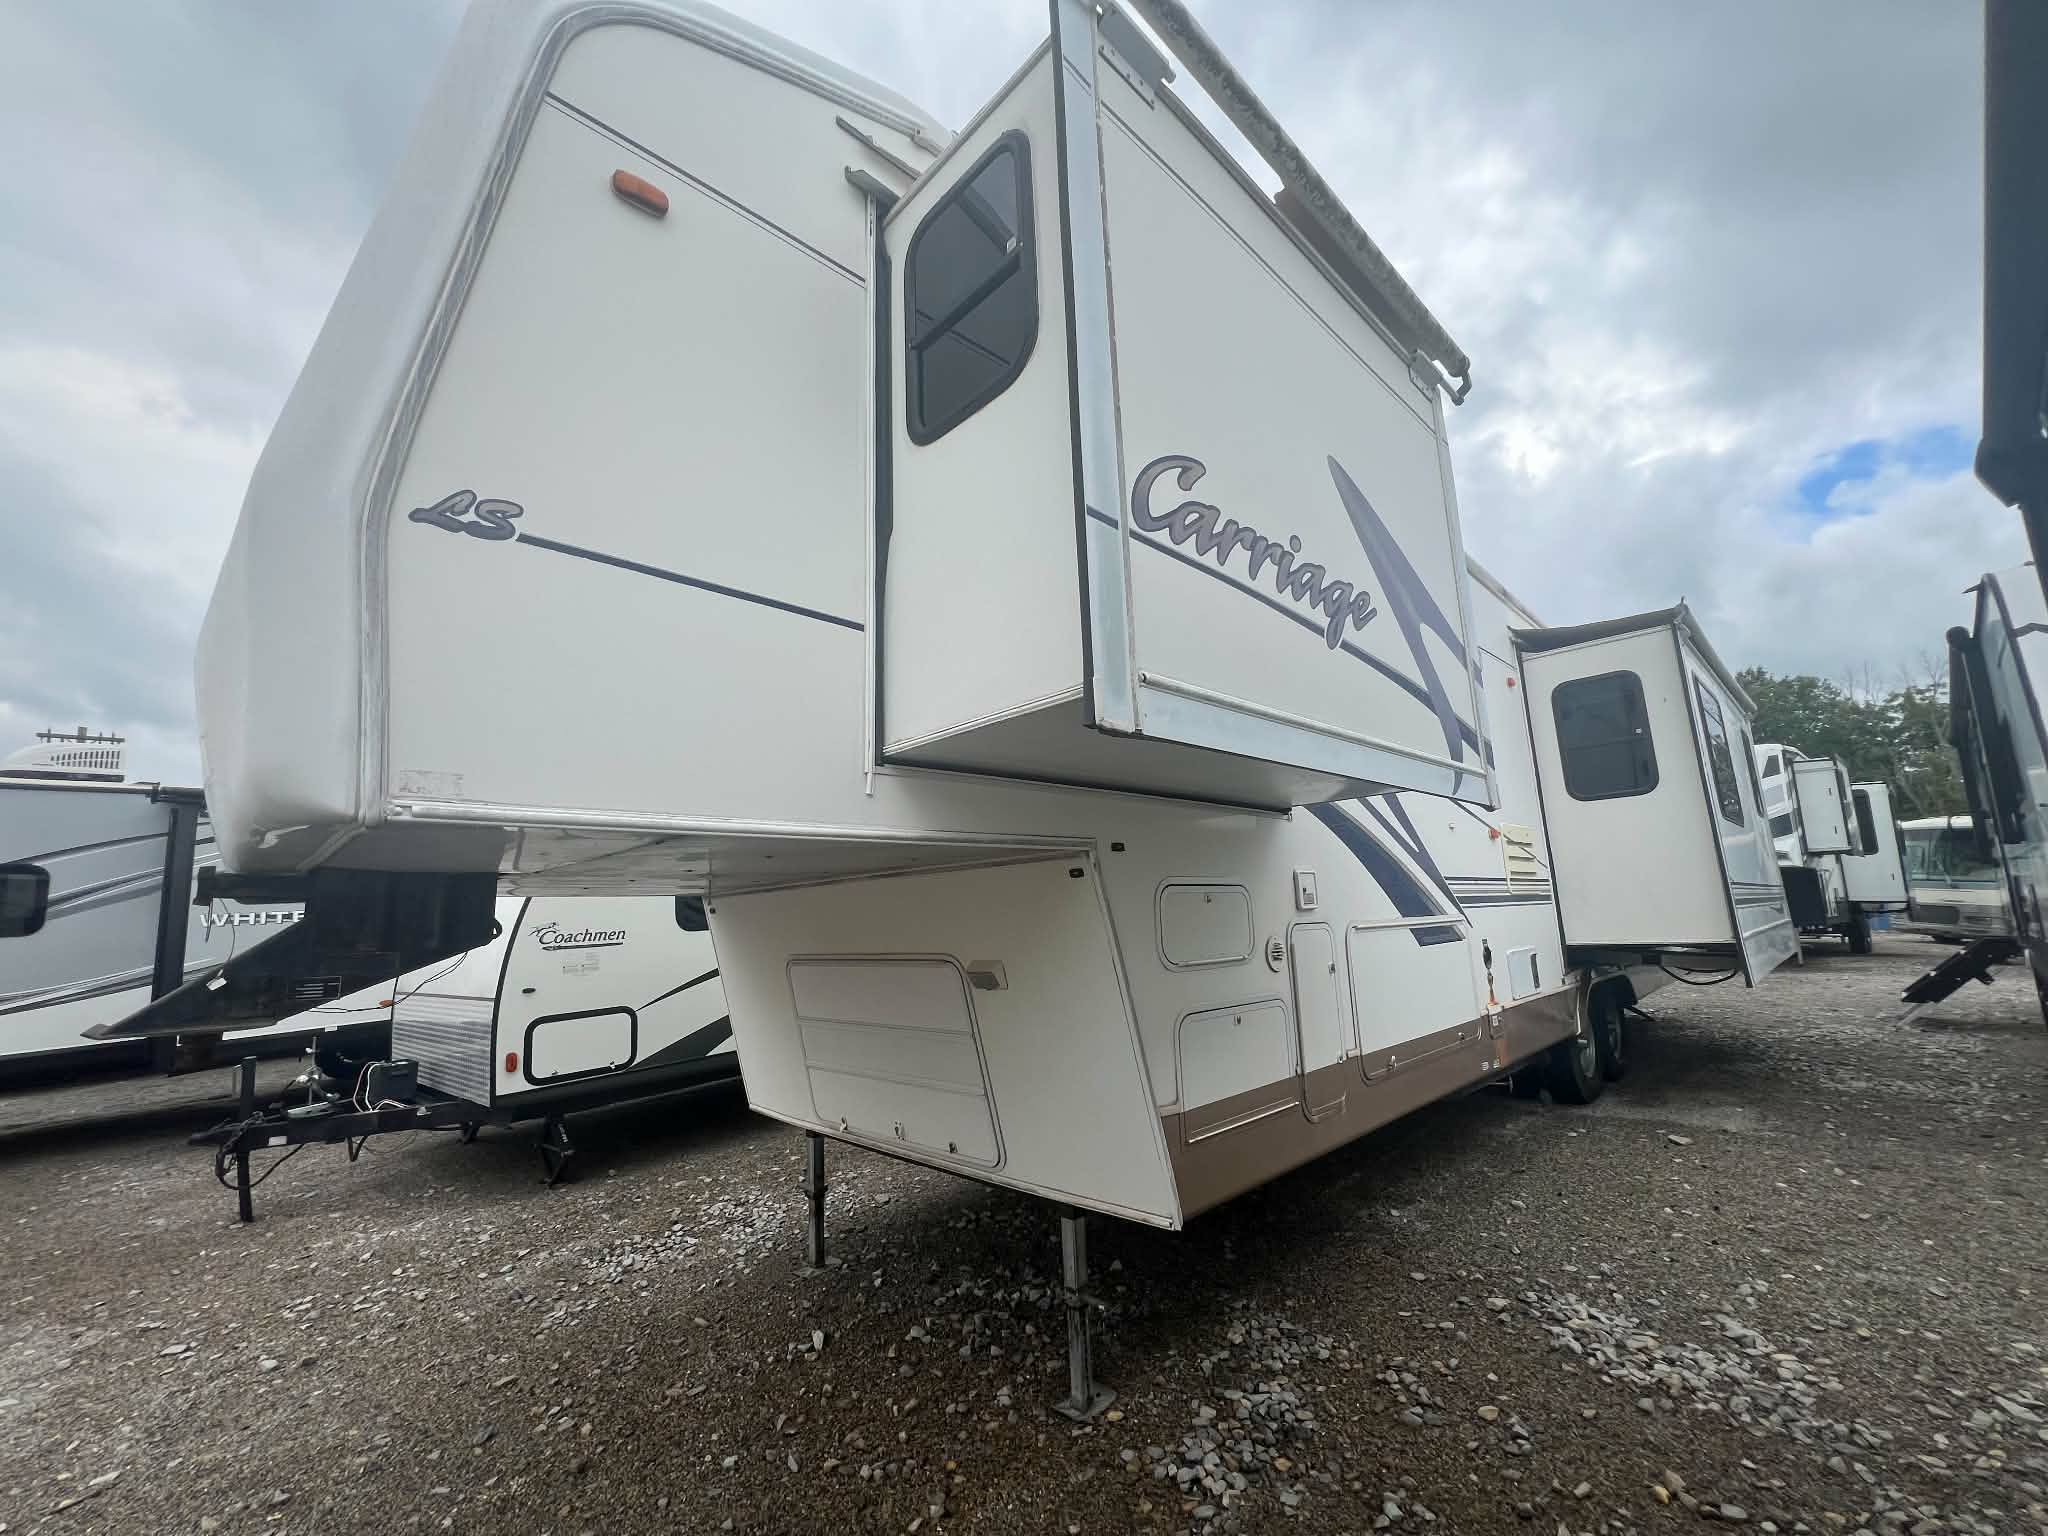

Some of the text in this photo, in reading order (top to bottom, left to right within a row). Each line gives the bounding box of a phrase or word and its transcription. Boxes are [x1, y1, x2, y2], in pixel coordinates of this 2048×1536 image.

[408, 489, 524, 541] LS
[1131, 454, 1377, 650] Carriage
[539, 928, 626, 944] Coachmen
